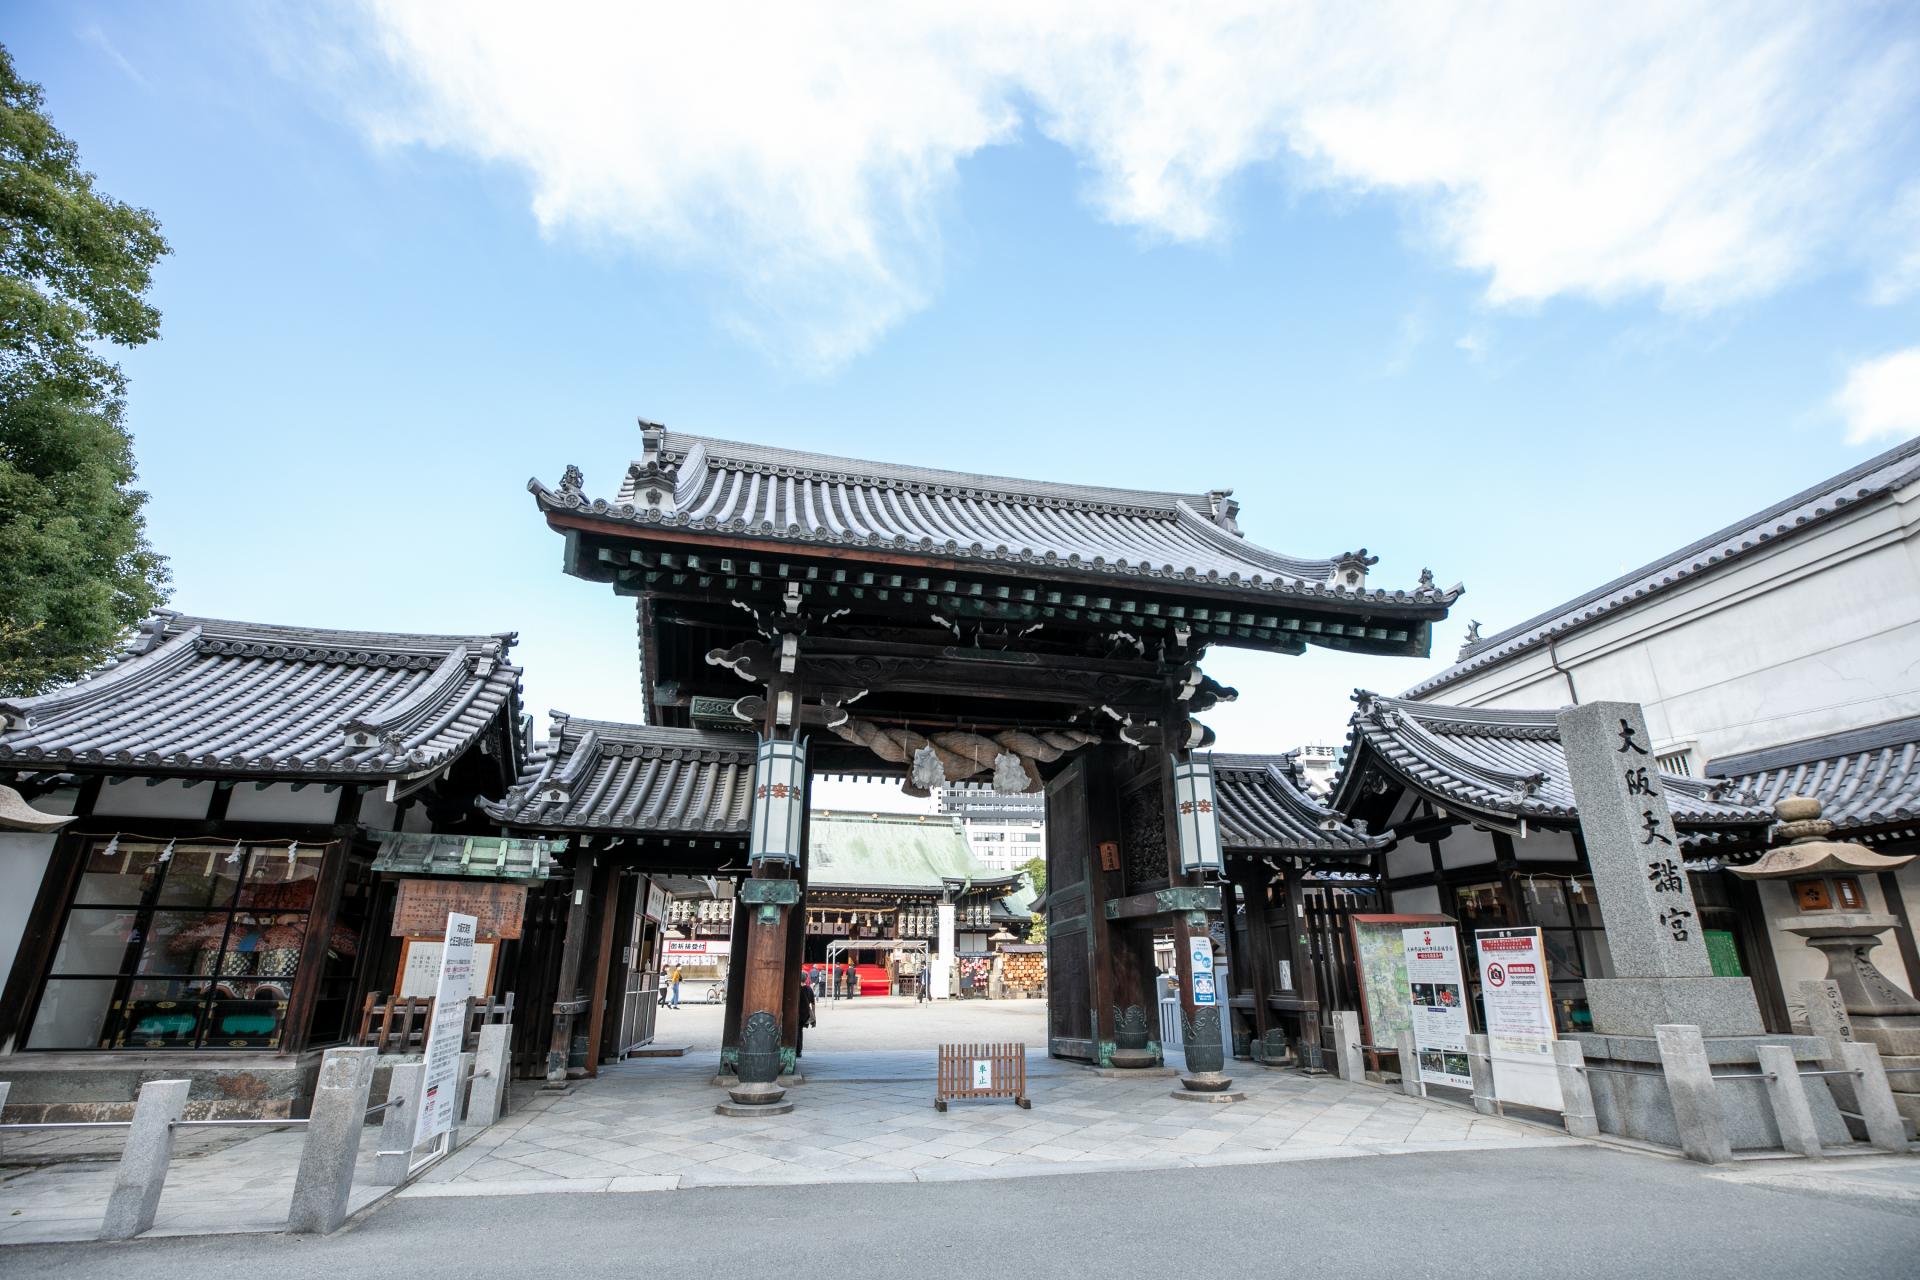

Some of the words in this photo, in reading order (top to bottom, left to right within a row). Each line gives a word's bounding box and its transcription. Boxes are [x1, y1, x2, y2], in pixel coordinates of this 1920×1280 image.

[1617, 718, 1692, 942] 大阪天満宮
